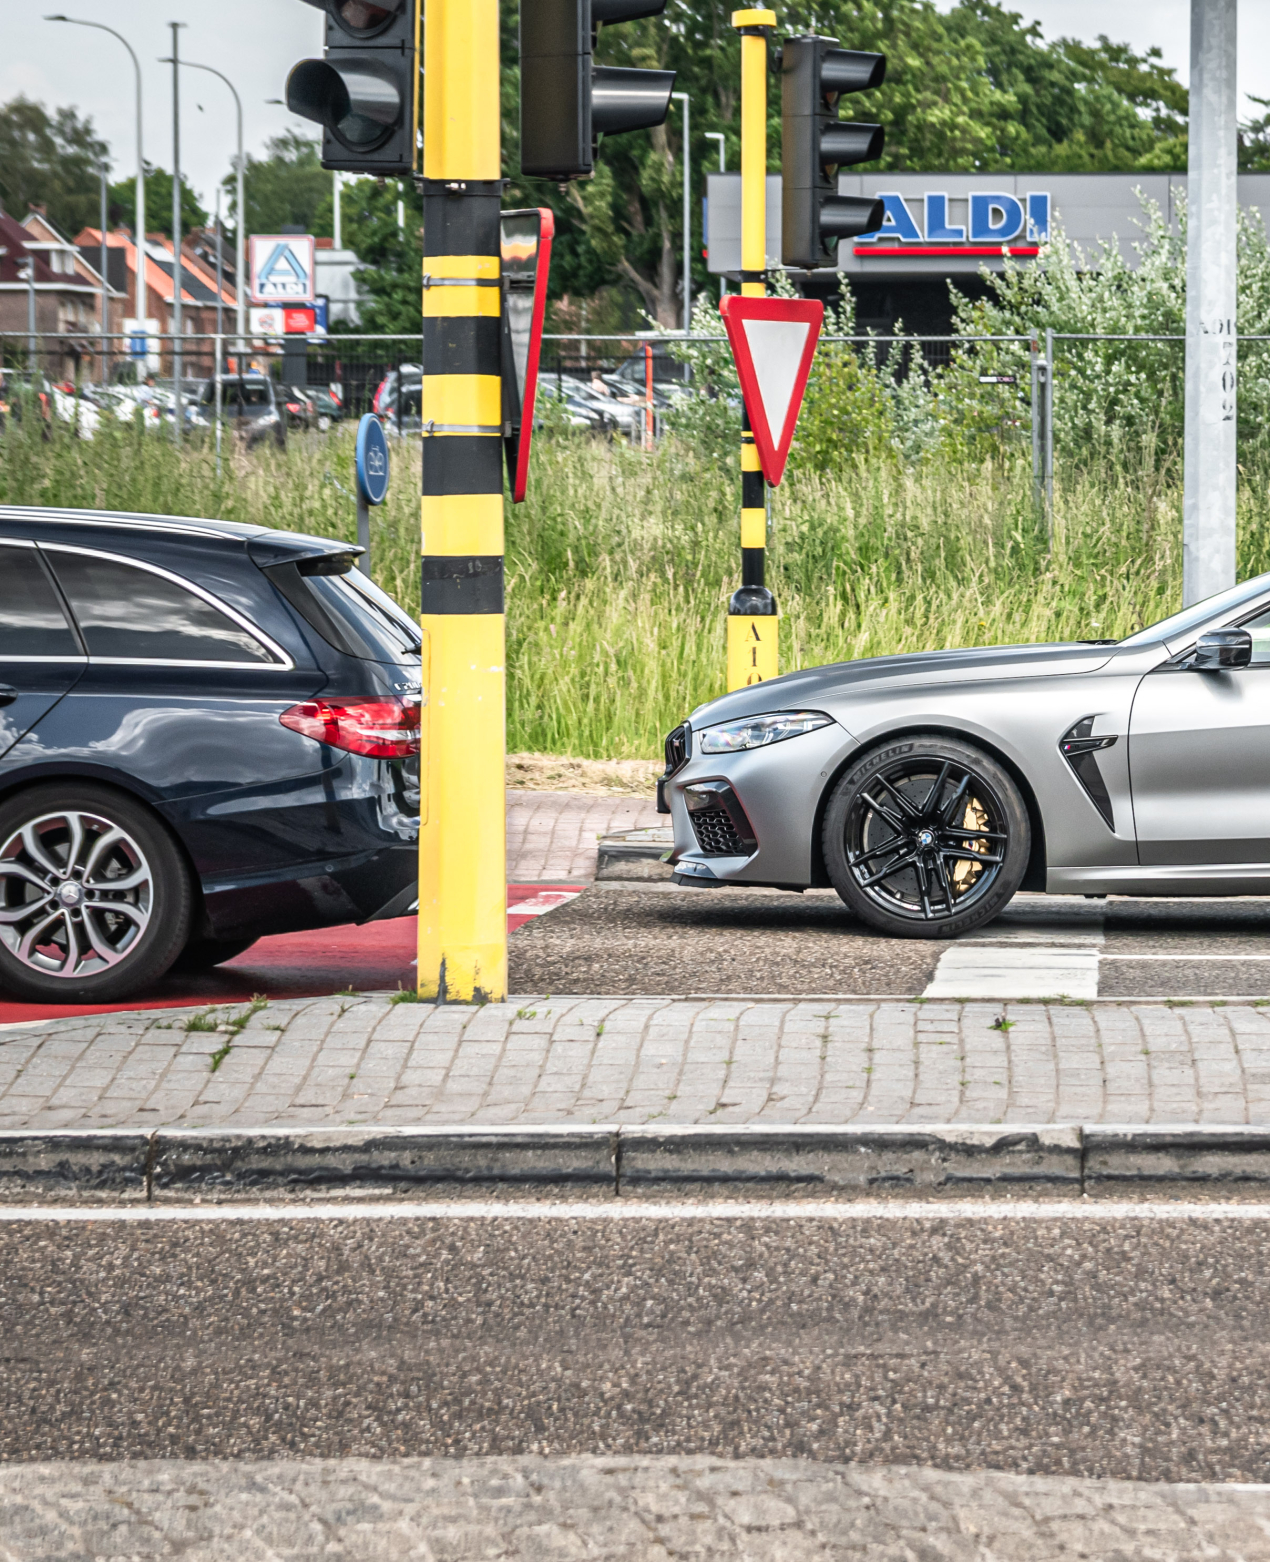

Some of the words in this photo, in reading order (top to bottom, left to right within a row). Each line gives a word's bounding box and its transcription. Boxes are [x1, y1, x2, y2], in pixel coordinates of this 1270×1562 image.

[854, 192, 1050, 242] ALDI
[259, 283, 307, 294] ALDI
[852, 743, 912, 784] MICHELIN
[941, 895, 998, 932] MICHELIN
